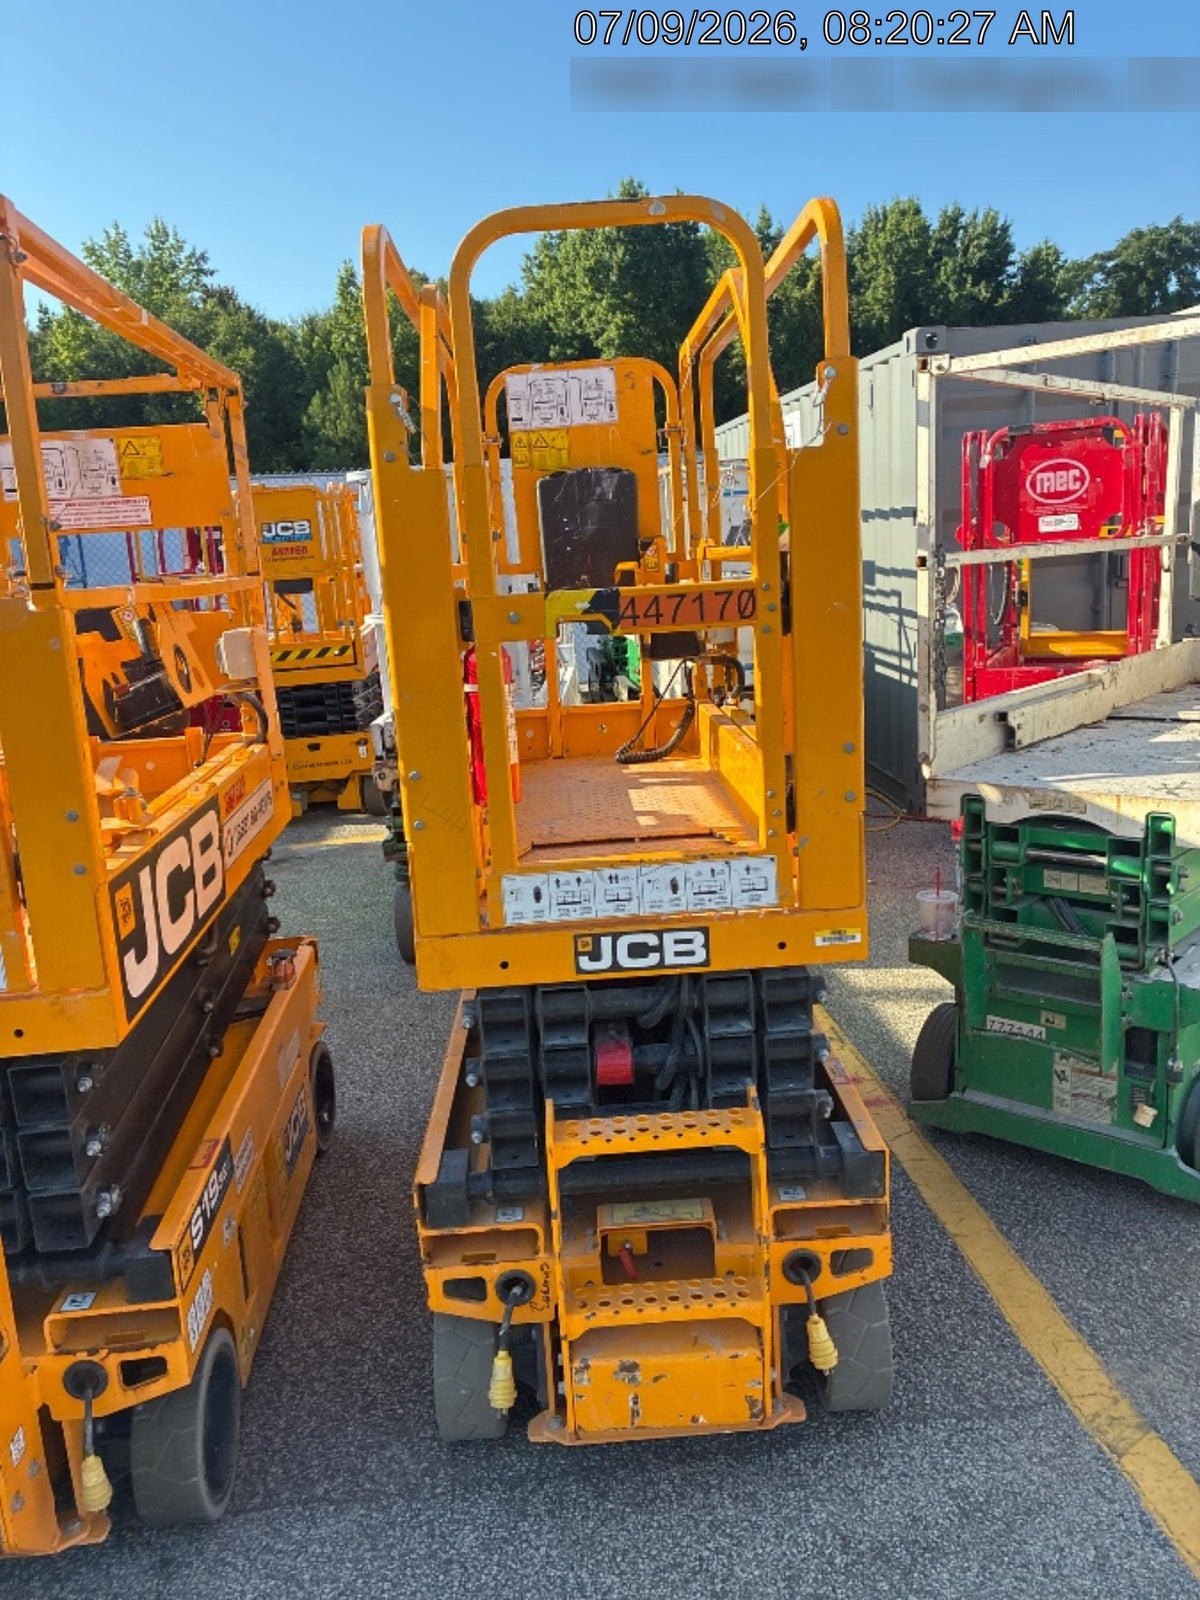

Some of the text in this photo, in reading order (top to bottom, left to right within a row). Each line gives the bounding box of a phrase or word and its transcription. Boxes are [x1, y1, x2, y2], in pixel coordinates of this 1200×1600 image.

[262, 520, 310, 536] JCB
[620, 588, 757, 626] 447170
[123, 810, 224, 998] JCB
[578, 931, 706, 971] JCB
